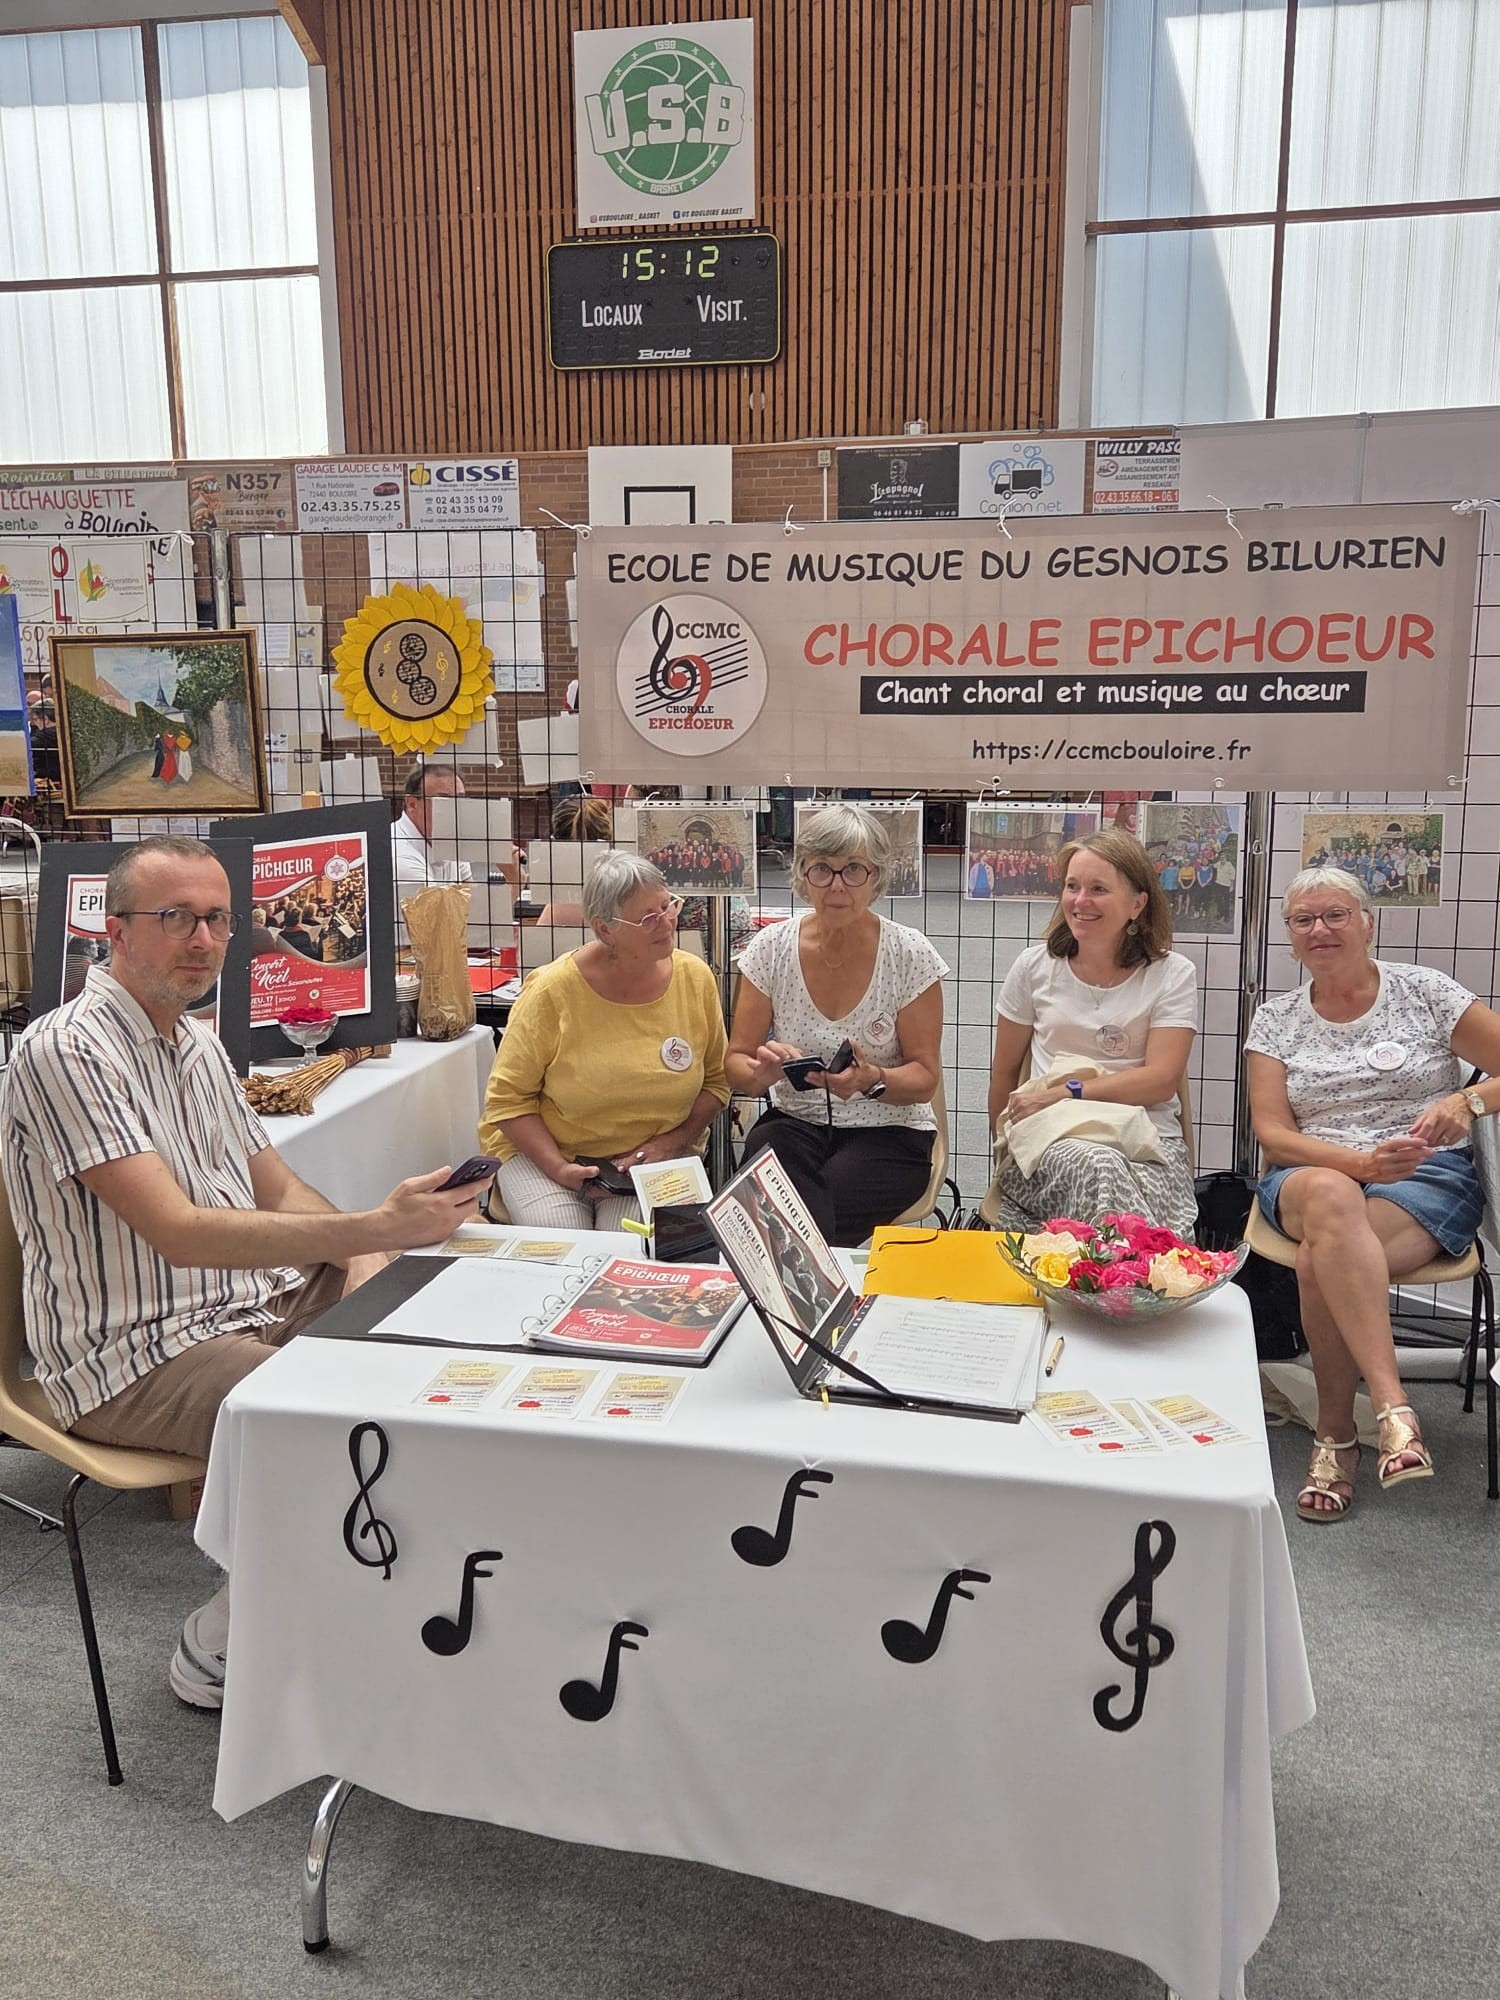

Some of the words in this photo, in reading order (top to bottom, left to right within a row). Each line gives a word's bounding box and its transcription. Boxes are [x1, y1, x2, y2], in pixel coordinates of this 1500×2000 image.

[650, 182, 684, 194] BASKET
[622, 245, 719, 281] 15:12
[637, 347, 692, 360] Bodet
[1098, 442, 1143, 455] WILLY
[296, 464, 335, 474] GARAGE
[338, 464, 370, 473] LAUDE
[392, 463, 403, 473] M
[435, 460, 517, 483] CISSÉ
[226, 473, 282, 490] N357
[301, 500, 401, 513] 02.43.35.75.25
[449, 496, 461, 505] 43
[463, 496, 475, 504] 35
[450, 506, 462, 514] 43
[463, 506, 476, 514] 35
[608, 553, 711, 583] ECOLE
[726, 552, 772, 582] DE
[787, 550, 964, 587] MUSIQUE
[981, 550, 1030, 579] DU
[1047, 544, 1229, 577] GESNOIS
[1247, 536, 1446, 573] BILURIEN
[675, 622, 741, 639] CCMC
[803, 618, 1063, 668] CHORALE
[1087, 613, 1436, 667] EPICHOEUR
[875, 680, 952, 704] Chant
[962, 681, 1044, 704] choral
[1055, 682, 1087, 703] et
[1097, 681, 1203, 709] musique
[1216, 683, 1248, 702] au
[1259, 677, 1351, 702] chœur
[665, 705, 714, 714] CHORALE
[648, 718, 735, 730] EPICHOEUR
[972, 739, 1251, 765] https://ccmcbouloire.fr
[79, 895, 103, 911] EPI
